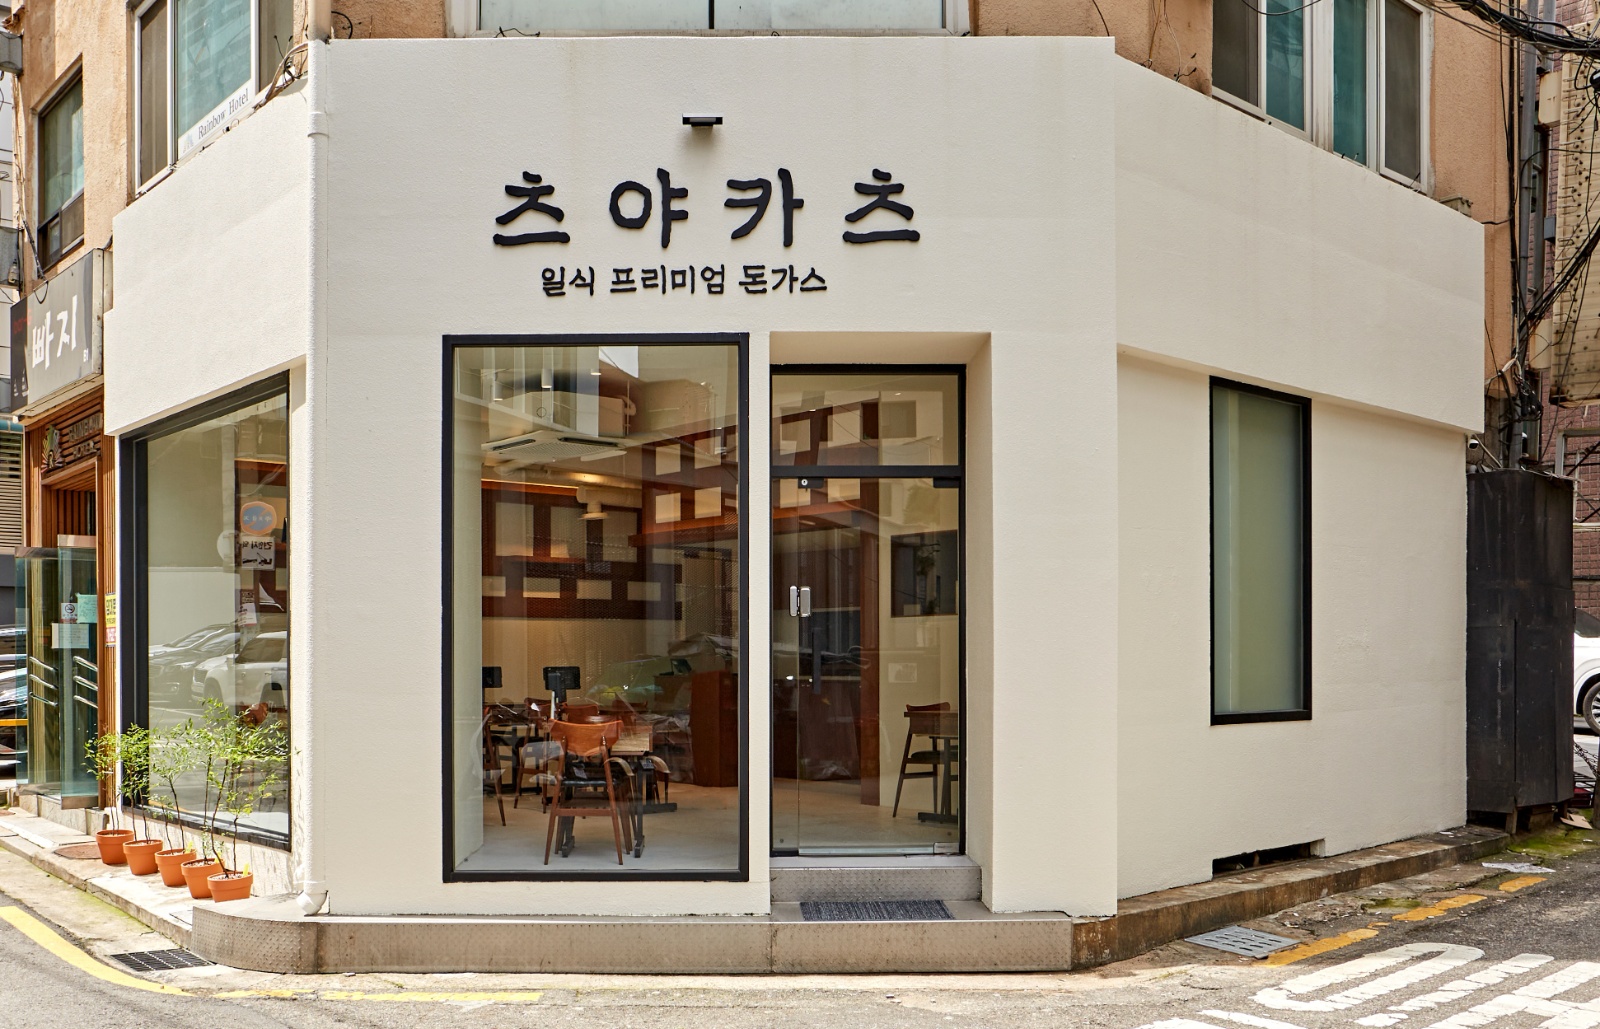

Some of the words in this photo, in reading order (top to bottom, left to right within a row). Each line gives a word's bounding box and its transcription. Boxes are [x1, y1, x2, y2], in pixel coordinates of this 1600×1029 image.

[198, 109, 226, 140] Rainbow
[229, 88, 249, 116] Hotel
[493, 168, 920, 249] 츠야카츠
[541, 265, 596, 298] 일식
[609, 264, 726, 296] 프리미엄
[738, 263, 828, 294] 돈가스
[32, 295, 78, 371] 빠지
